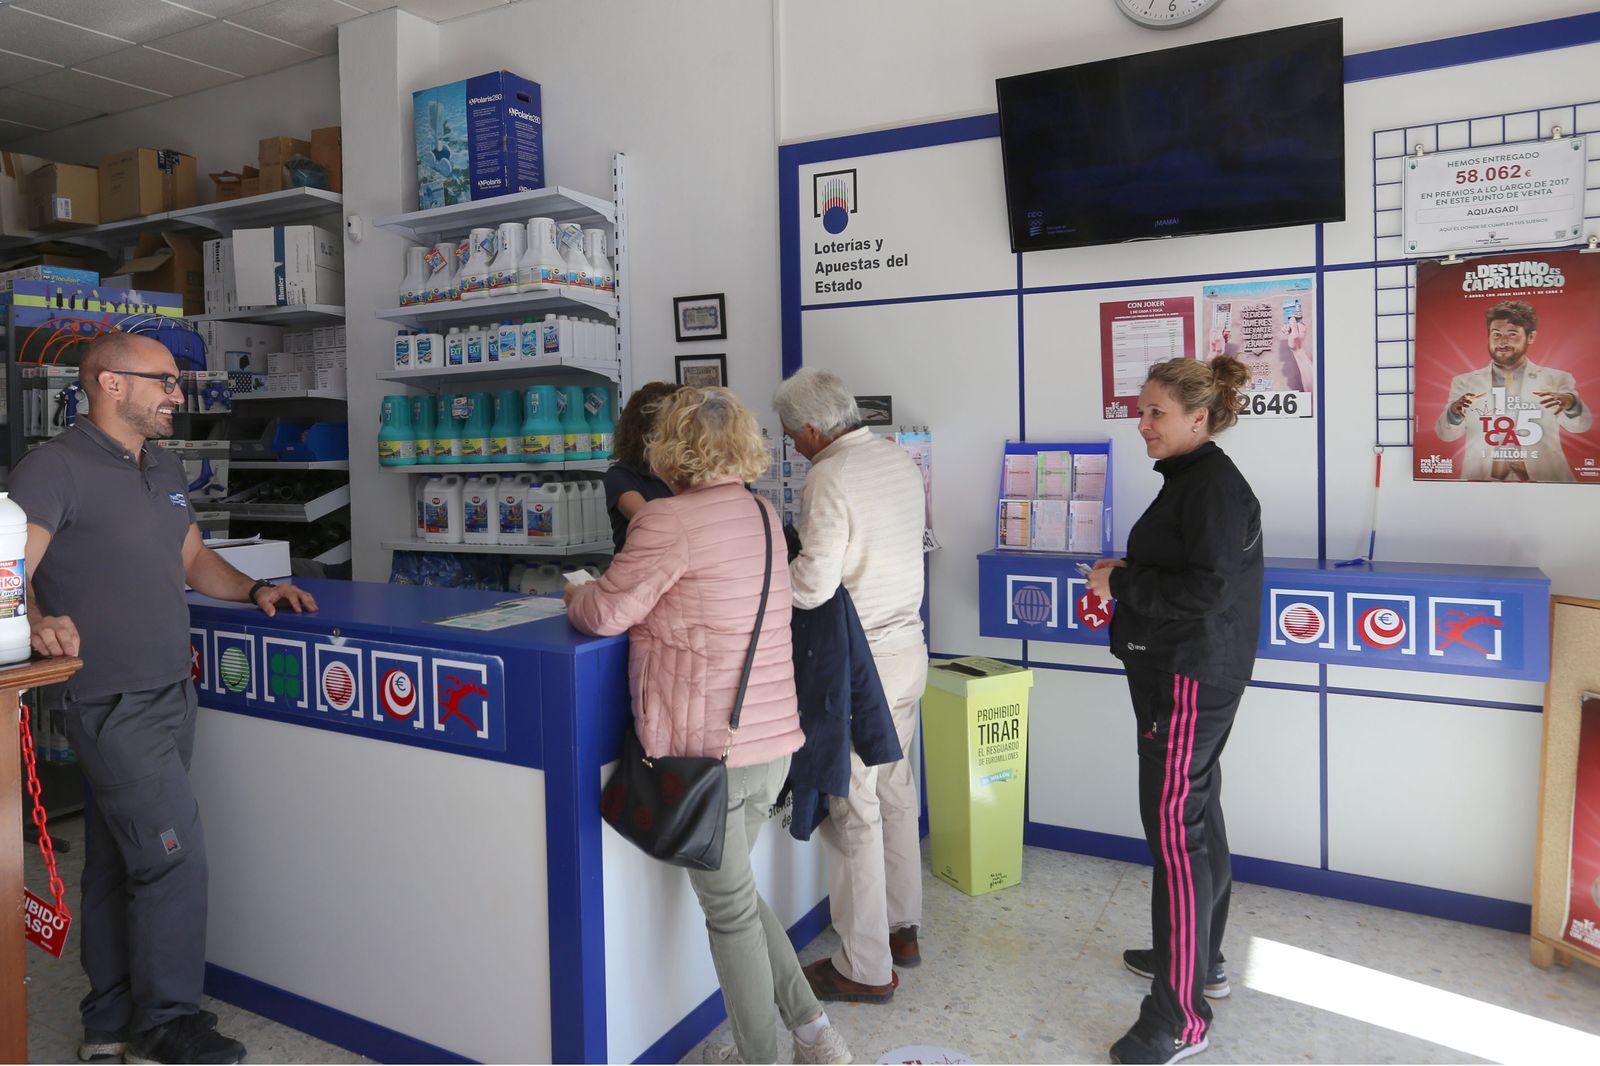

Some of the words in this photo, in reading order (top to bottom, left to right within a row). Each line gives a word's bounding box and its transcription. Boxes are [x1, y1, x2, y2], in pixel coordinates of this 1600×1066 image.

[1447, 157, 1481, 168] HEMOS
[1482, 151, 1540, 165] ENTREGADO
[1455, 164, 1522, 185] 58.062
[1421, 191, 1433, 200] EN
[1435, 187, 1475, 199] PREMIOS
[1476, 186, 1484, 194] A
[1485, 185, 1498, 194] LO
[1499, 181, 1532, 192] LARGO
[1534, 179, 1547, 189] DE
[1549, 177, 1570, 187] 2017
[1435, 198, 1448, 206] EN
[1450, 196, 1470, 205] ESTE
[1472, 192, 1504, 203] PUNTO
[1506, 191, 1520, 199] DE
[1522, 188, 1553, 198] VENTA
[1466, 205, 1519, 218] AQUAGADI
[1488, 220, 1514, 229] CUMPLEN
[814, 238, 871, 255] Loterías
[875, 238, 884, 252] y
[815, 257, 880, 276] Apuestas
[886, 253, 908, 268] del
[1465, 271, 1478, 280] EL
[1477, 261, 1550, 278] DESTINO
[1550, 267, 1561, 275] ES
[815, 279, 863, 294] Estado
[1462, 274, 1566, 293] CAPRICHOSO
[1127, 300, 1141, 309] CON
[1141, 299, 1165, 309] JOKER
[489, 344, 498, 352] EX
[1492, 386, 1506, 416] 1
[1507, 396, 1521, 404] DE
[1507, 402, 1537, 410] CADA
[1516, 409, 1544, 446] 5
[1490, 448, 1528, 459] MILLÓN
[977, 703, 1020, 723] PROHIBIDO
[977, 718, 1019, 746] TIRAR
[978, 747, 985, 757] EL
[986, 741, 1020, 756] RESGUARDO
[978, 758, 985, 767] DE
[985, 751, 1019, 765] EUROMILLONES
